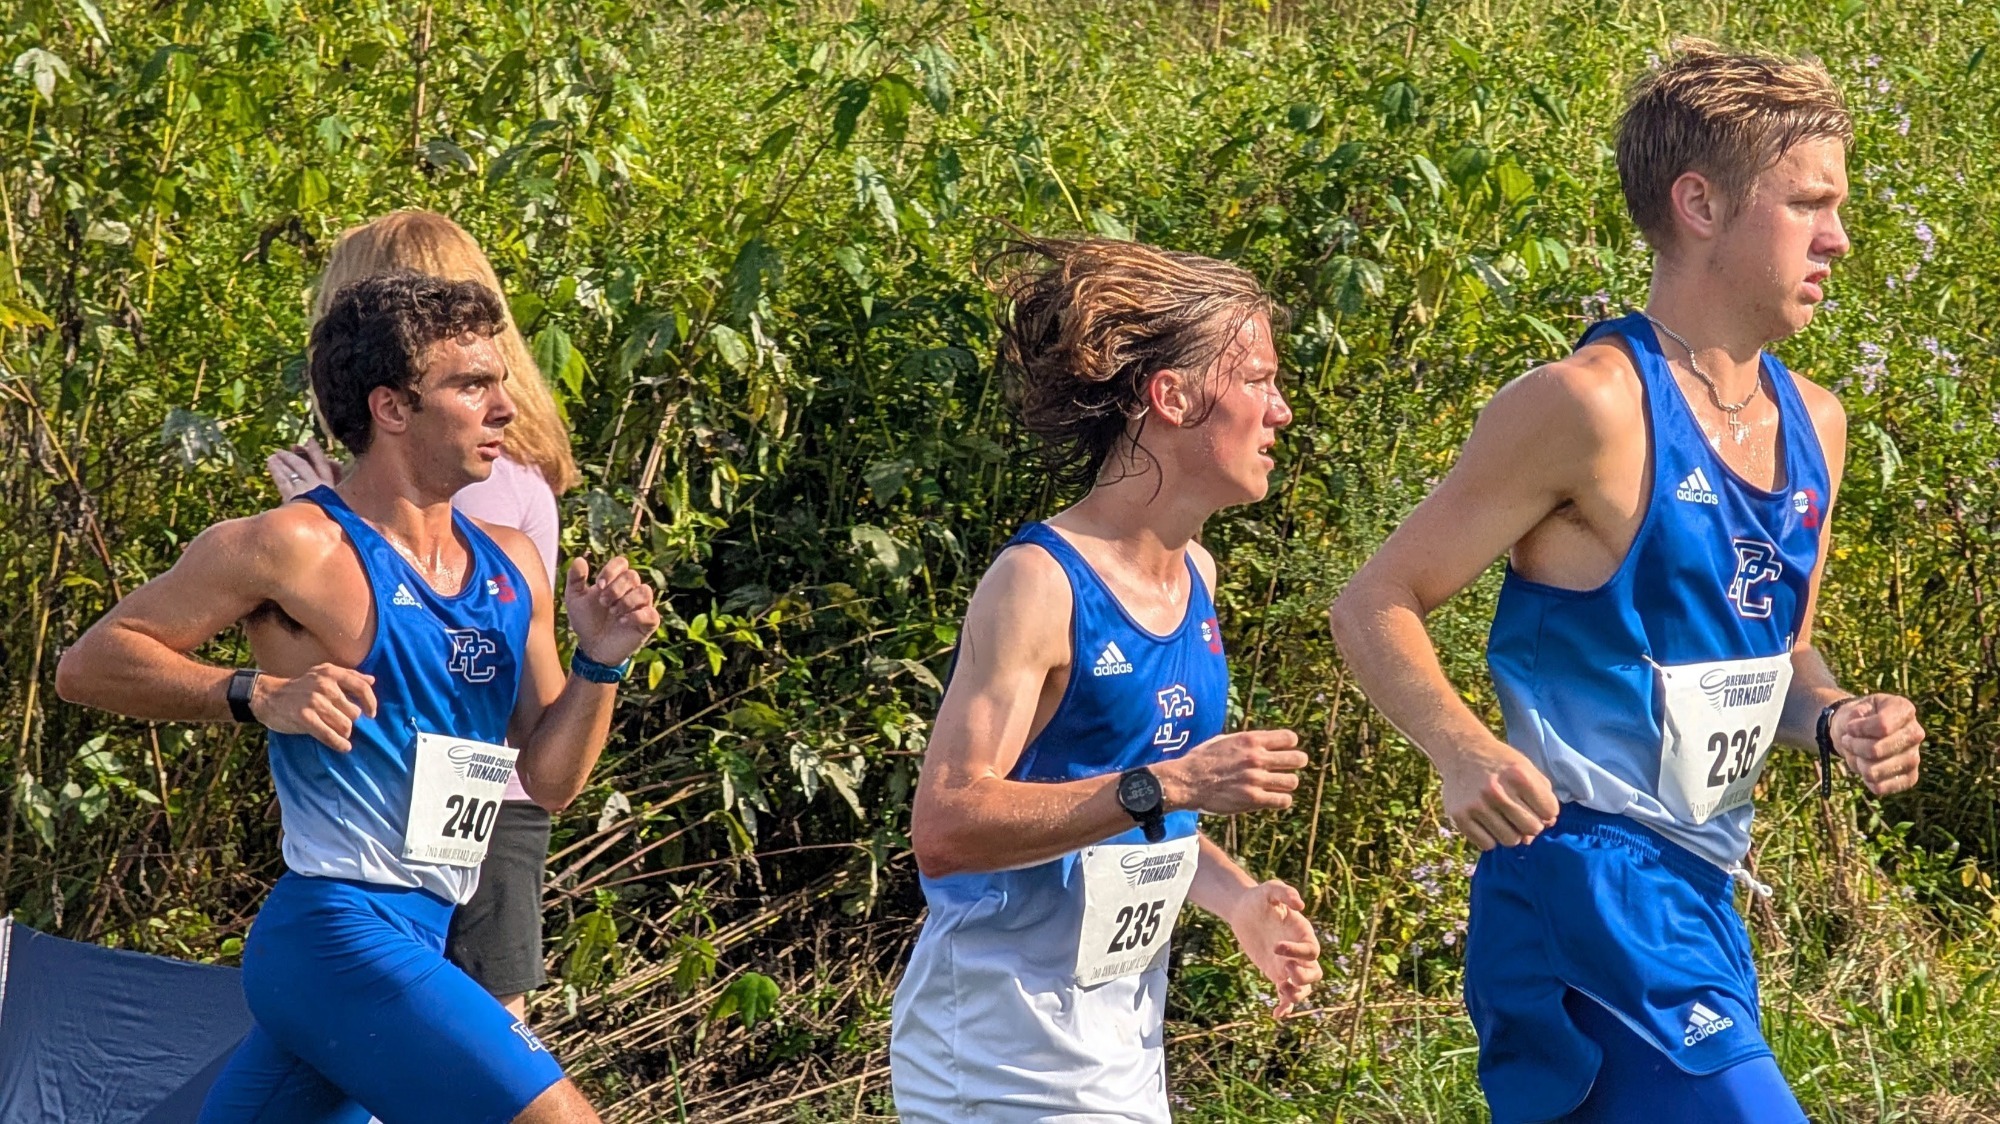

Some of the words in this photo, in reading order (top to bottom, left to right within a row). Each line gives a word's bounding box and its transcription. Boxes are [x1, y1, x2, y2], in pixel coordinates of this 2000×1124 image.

[1676, 488, 1719, 505] adidas
[1093, 661, 1133, 677] adidas
[1725, 673, 1756, 687] BREVARD
[1755, 670, 1779, 684] COLLEGE
[1723, 683, 1775, 708] TORNADOS
[1706, 725, 1761, 788] 236
[441, 794, 498, 843] 240
[1137, 862, 1181, 885] TORNADOS
[1107, 899, 1166, 954] 235
[1683, 1016, 1734, 1047] adidas
